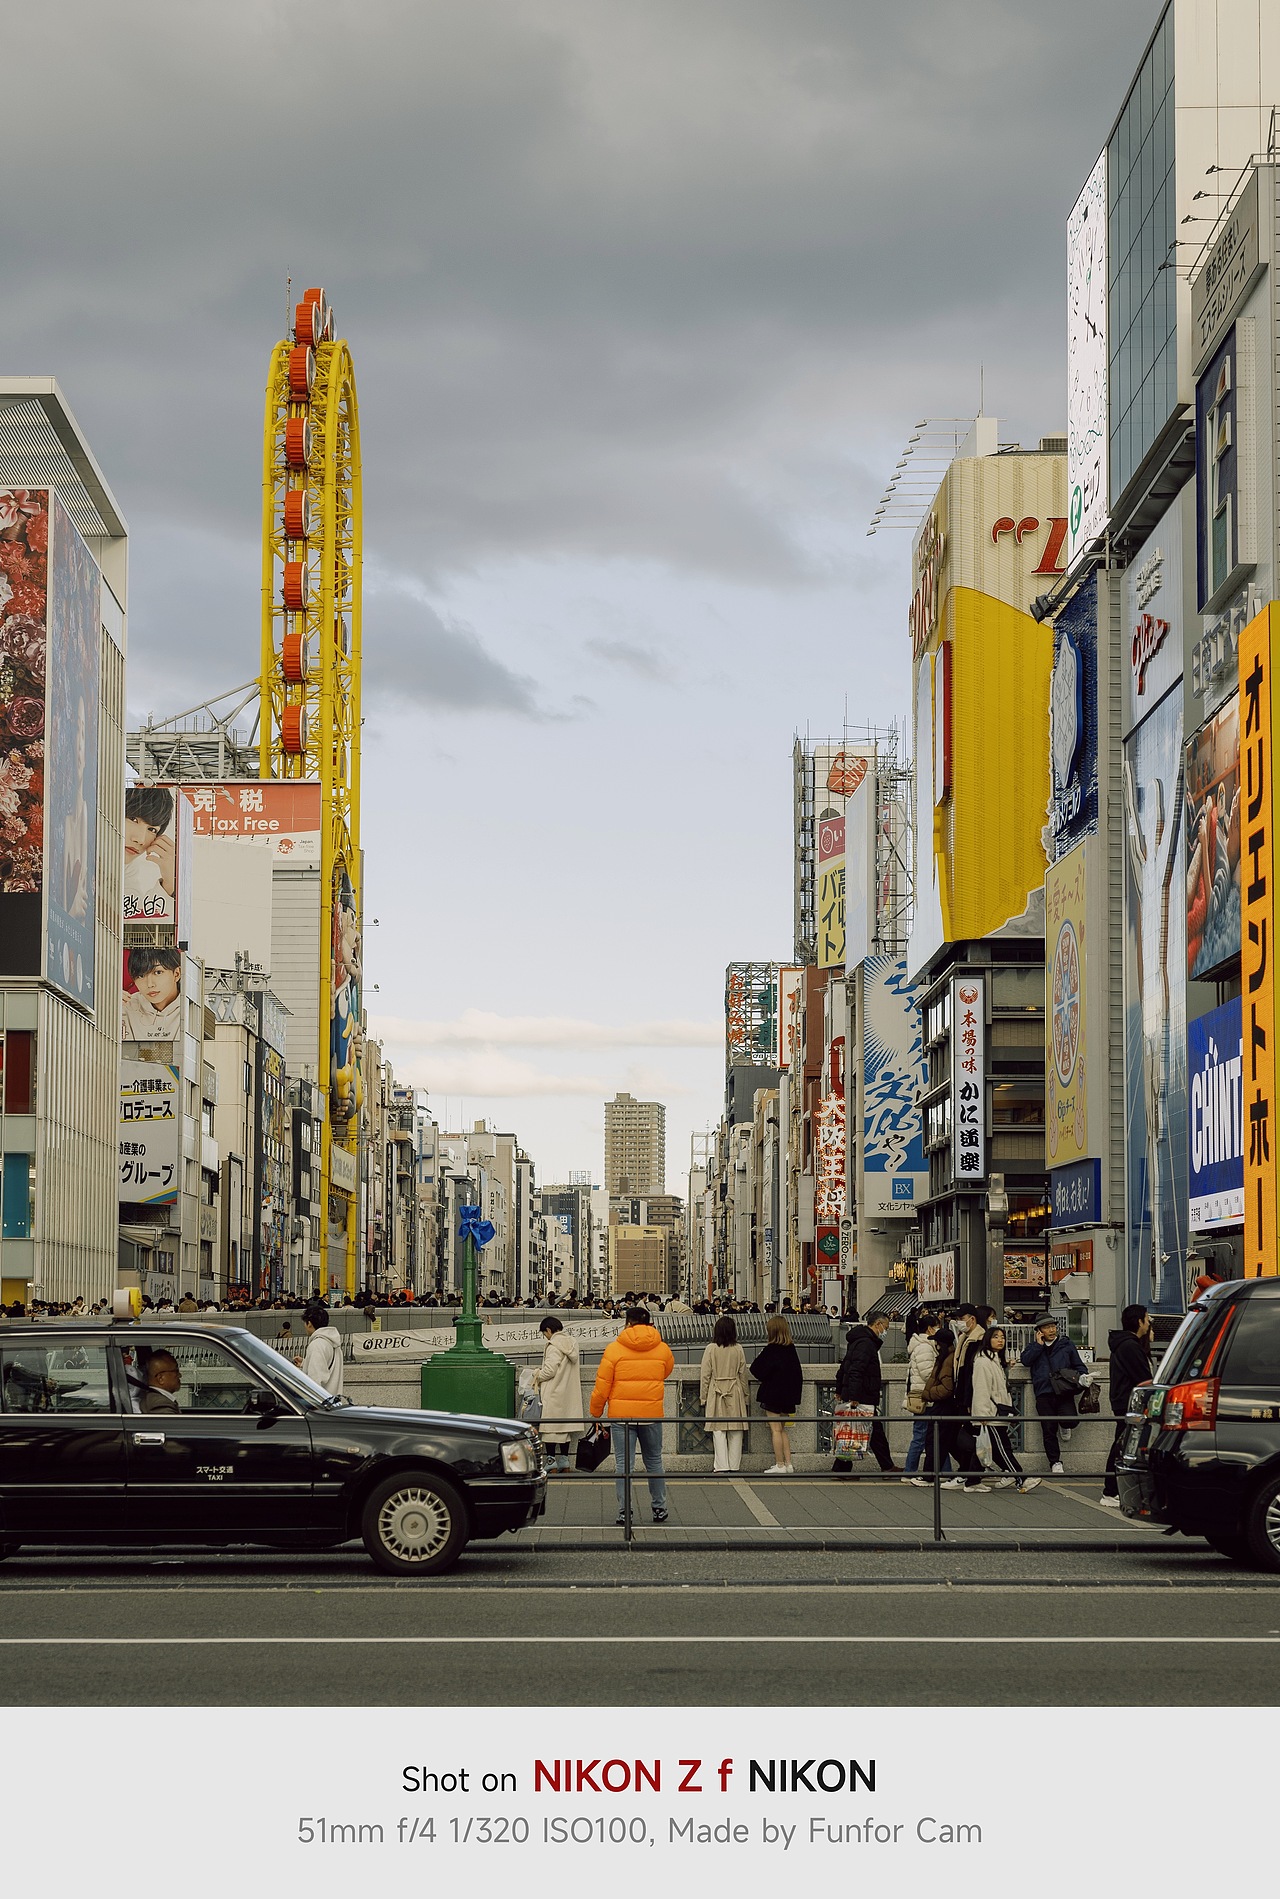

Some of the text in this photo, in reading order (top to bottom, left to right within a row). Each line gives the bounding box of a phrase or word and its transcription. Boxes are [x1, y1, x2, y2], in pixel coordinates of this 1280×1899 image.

[1083, 455, 1101, 514] ピップ
[1132, 613, 1170, 696] Glico
[210, 816, 239, 831] Tax
[244, 816, 280, 831] Free
[1246, 653, 1269, 1278] オリエントホー
[960, 1009, 978, 1074] 本場の味
[1192, 1055, 1244, 1174] CHINT
[815, 1091, 846, 1217] 大阪王将
[895, 1183, 911, 1194] BX
